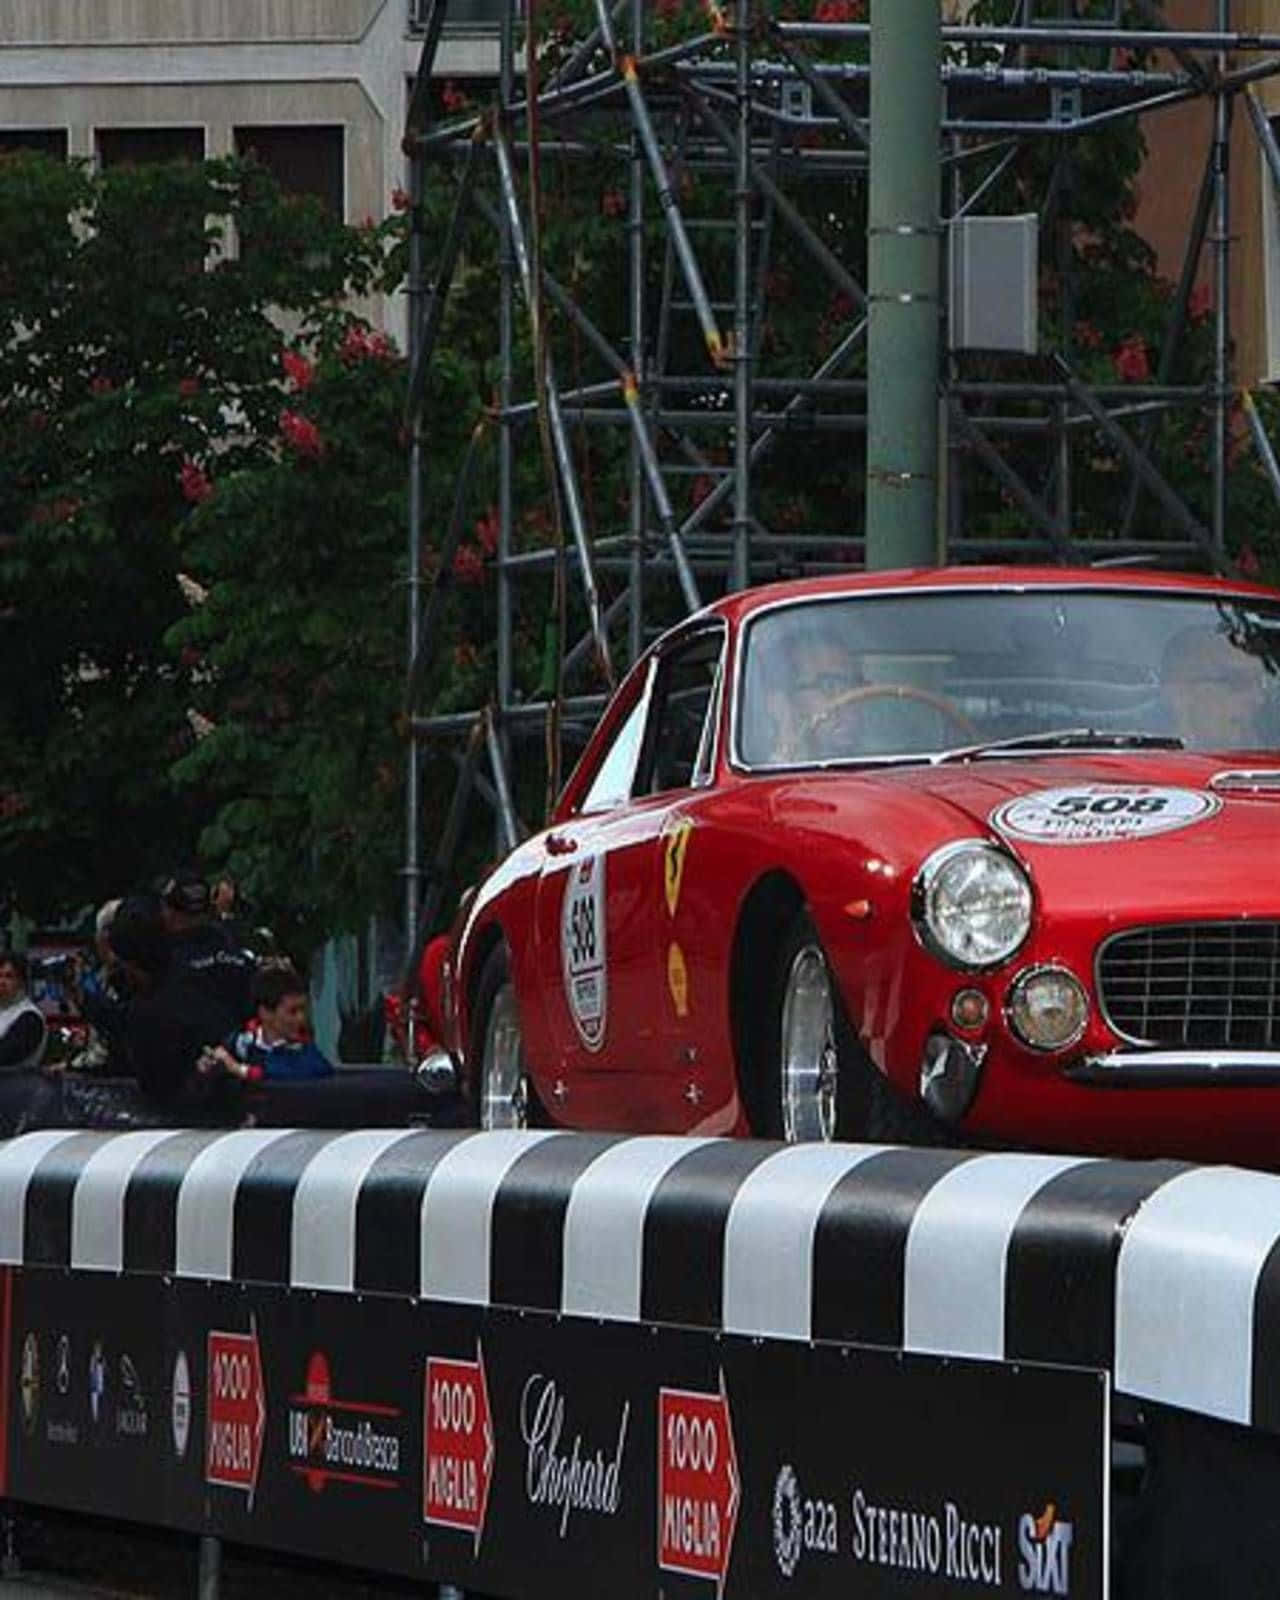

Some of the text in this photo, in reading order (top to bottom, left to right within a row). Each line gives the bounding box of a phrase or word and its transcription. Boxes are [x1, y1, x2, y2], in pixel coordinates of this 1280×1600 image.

[1050, 796, 1169, 817] 508
[213, 1352, 250, 1399] 1000
[289, 1410, 308, 1457] UBI
[431, 1379, 476, 1435] 1000
[520, 1373, 630, 1539] Chopard
[666, 1412, 718, 1473] 1000
[428, 1456, 477, 1512] MIGLIA
[663, 1497, 721, 1558] MIGLIA
[852, 1488, 1001, 1586] STEFANO RICCI
